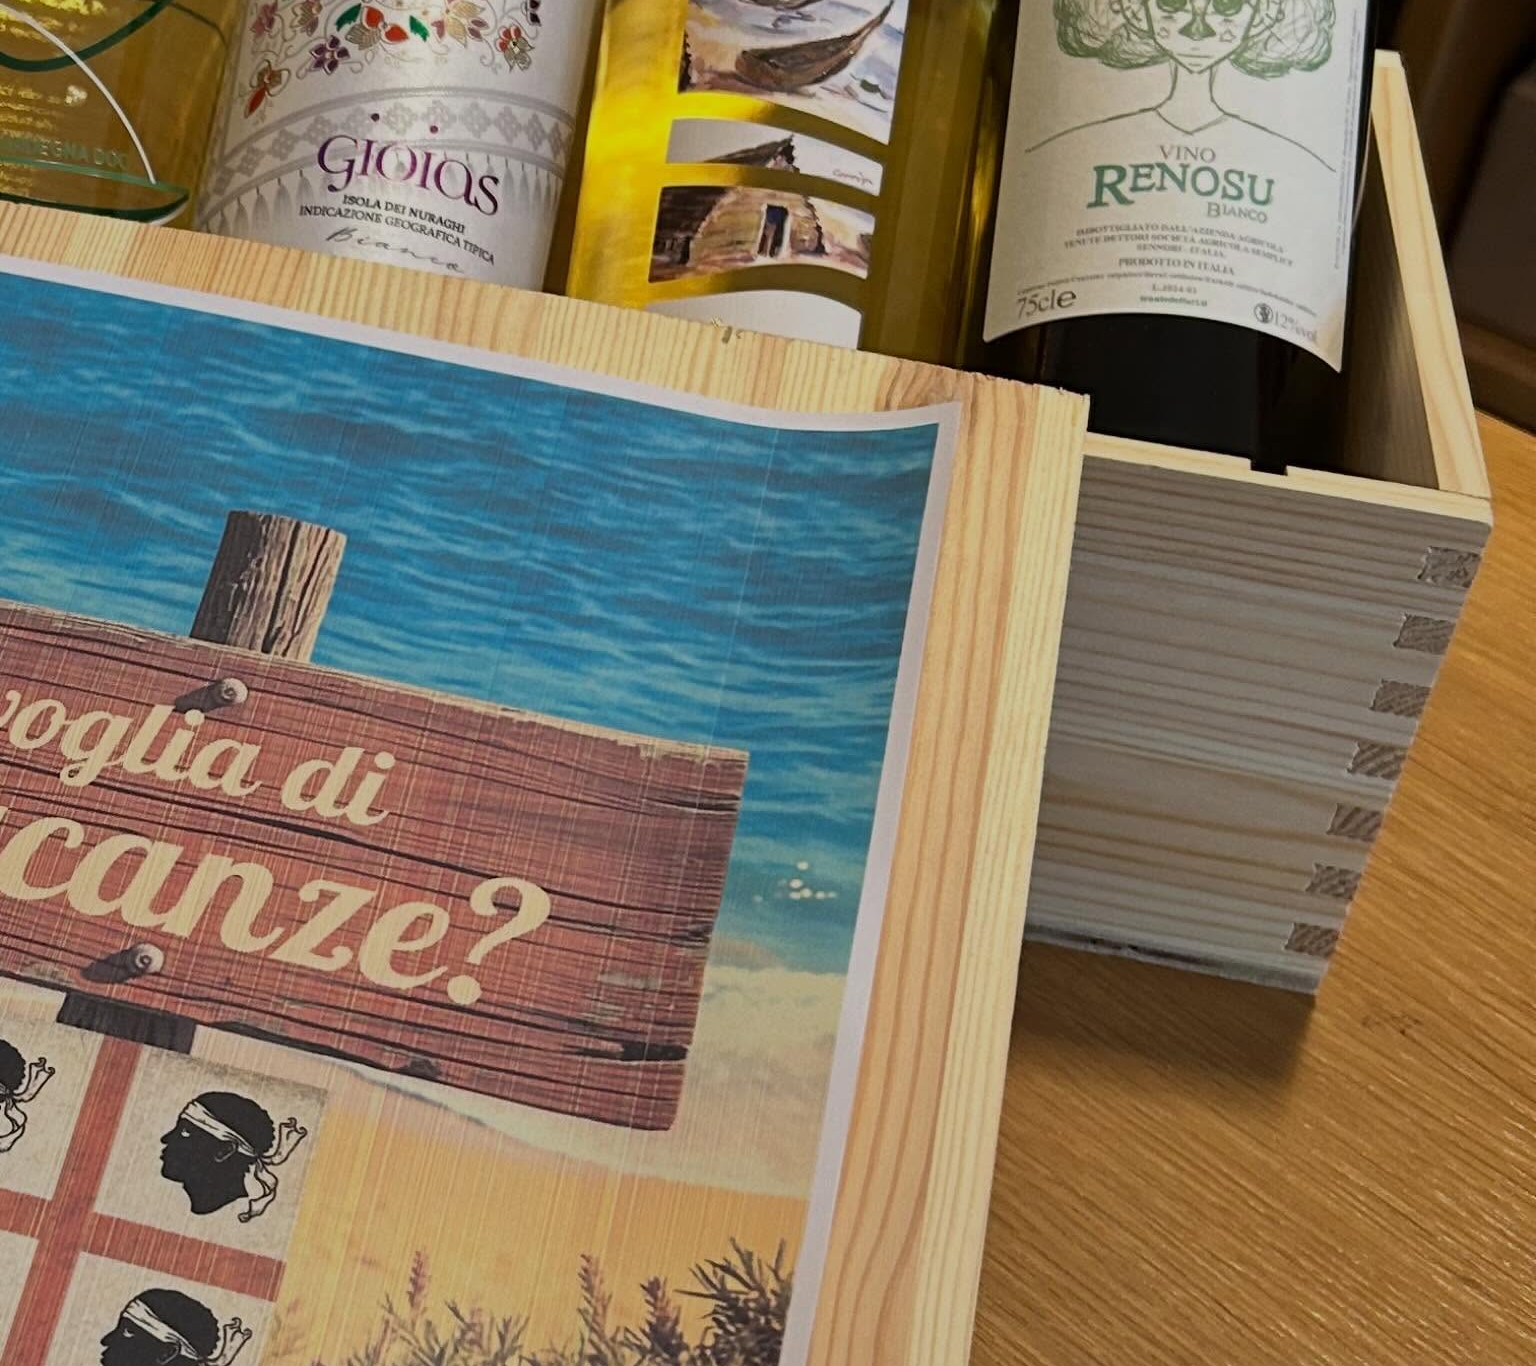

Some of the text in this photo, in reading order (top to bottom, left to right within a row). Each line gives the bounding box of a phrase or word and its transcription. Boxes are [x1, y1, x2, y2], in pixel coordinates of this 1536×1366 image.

[1158, 144, 1217, 164] VINO
[1086, 161, 1275, 210] RENOSU
[299, 204, 496, 266] INDICAZIONE GEOGRAFICA TIPICA
[342, 194, 466, 234] ISOLA DEI NURAGHI
[1118, 257, 1181, 268] PRODOTTO
[1197, 260, 1235, 275] ITALIA
[278, 743, 397, 828] di
